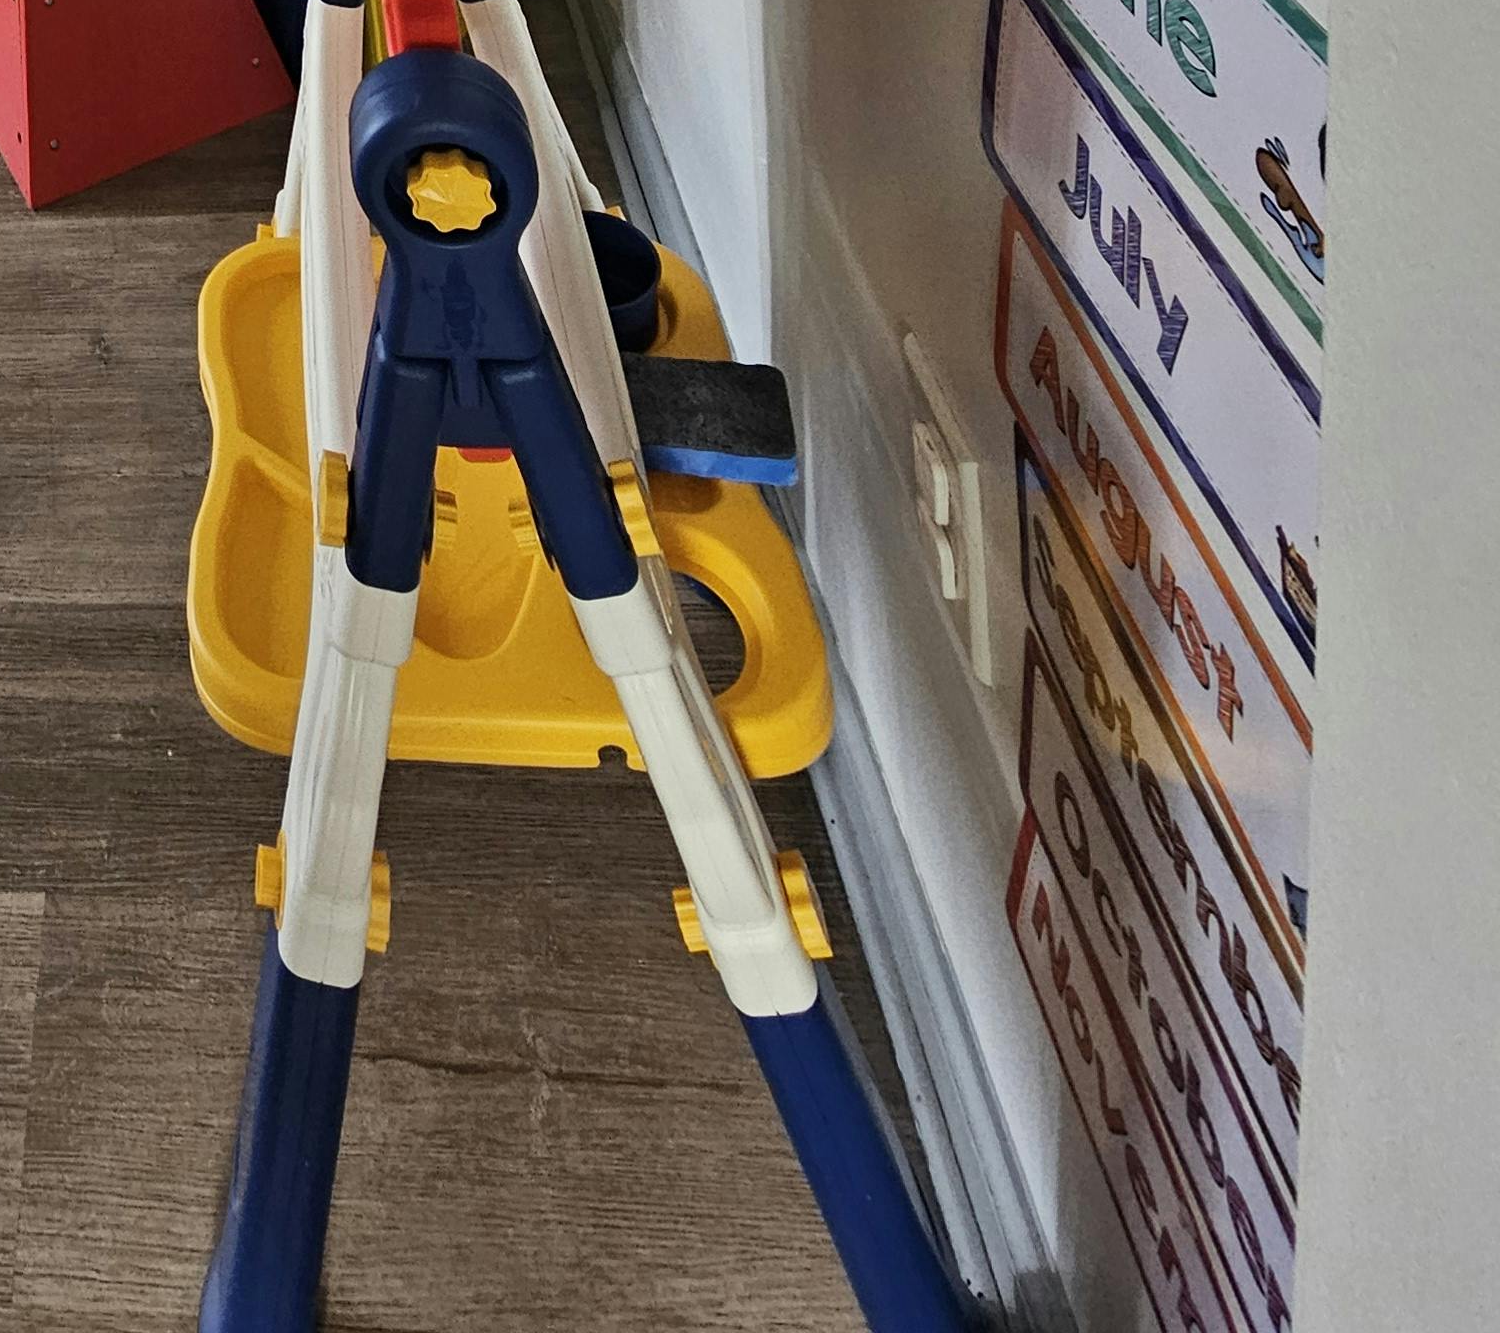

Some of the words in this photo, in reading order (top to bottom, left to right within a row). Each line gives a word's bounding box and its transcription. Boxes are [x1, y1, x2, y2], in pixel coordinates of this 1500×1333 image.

[1058, 133, 1190, 376] July
[1029, 325, 1244, 743] August
[1033, 513, 1301, 1136] Septembe
